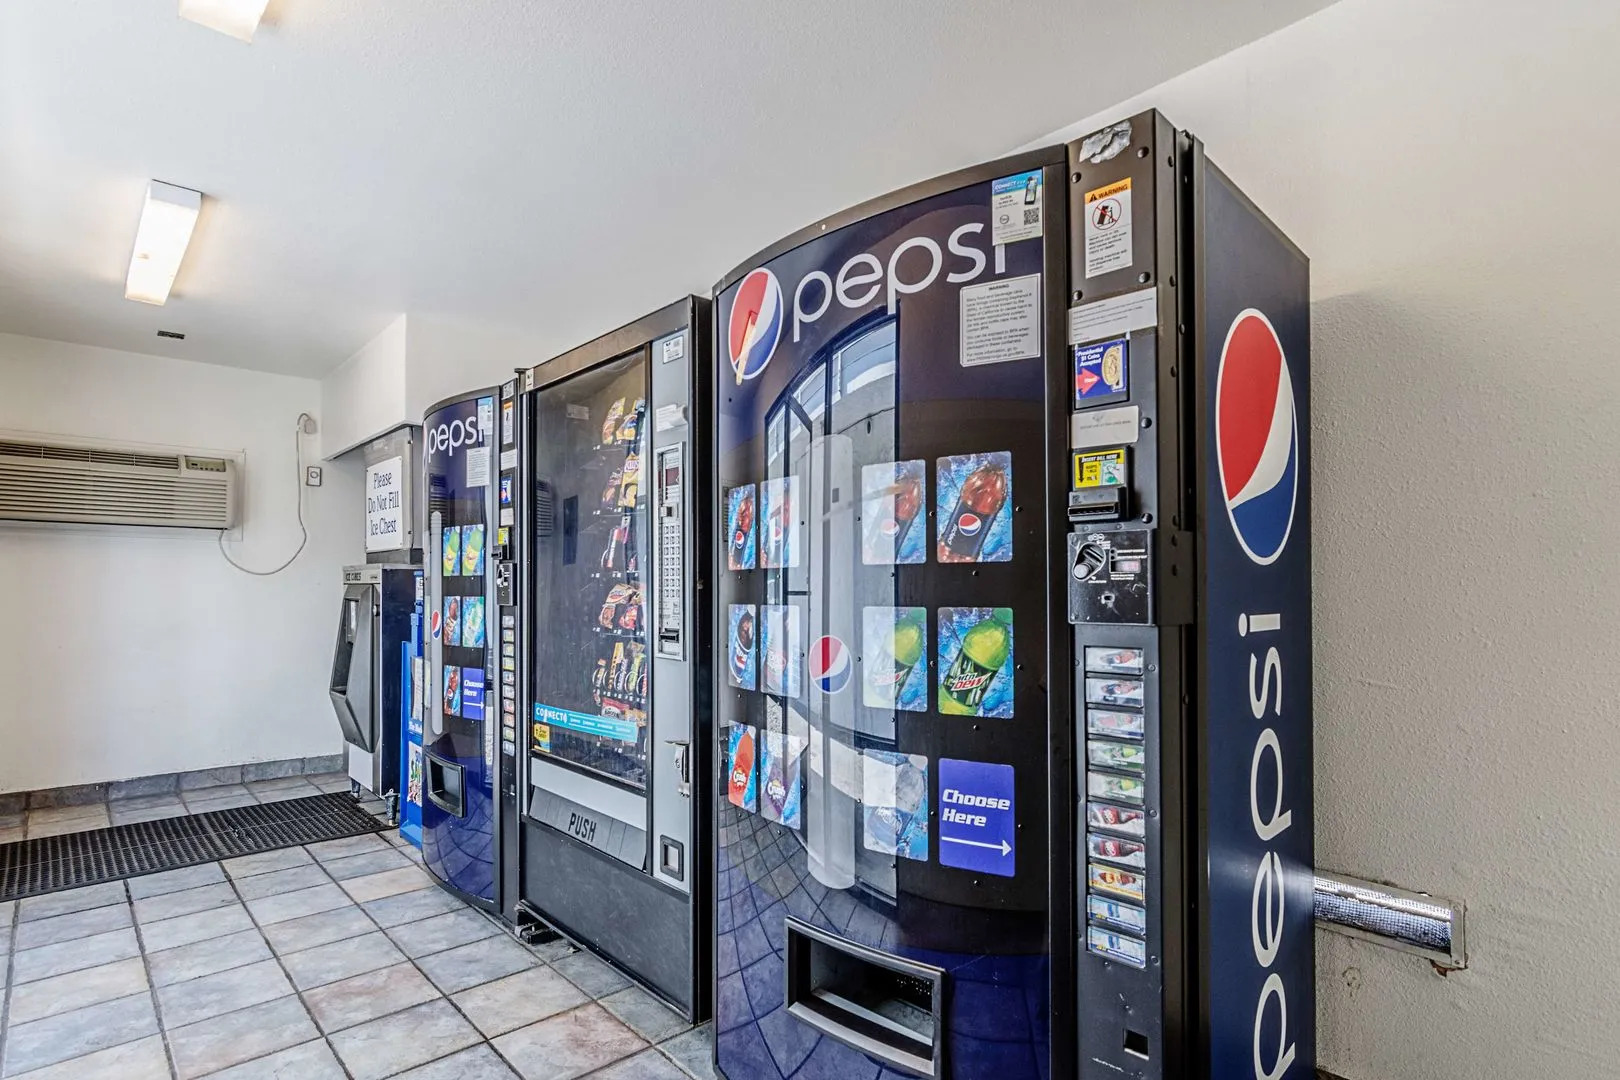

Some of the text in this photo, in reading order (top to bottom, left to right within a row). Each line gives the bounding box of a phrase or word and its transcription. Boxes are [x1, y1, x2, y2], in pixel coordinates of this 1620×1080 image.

[1098, 184, 1128, 199] WARNING
[373, 472, 392, 490] Please
[368, 491, 400, 514] Do Not Fill
[370, 517, 397, 536] Ice Chest
[942, 788, 1011, 811] Choose
[567, 812, 597, 843] PUSH
[942, 807, 987, 827] Here
[1238, 612, 1295, 1080] pepsi
